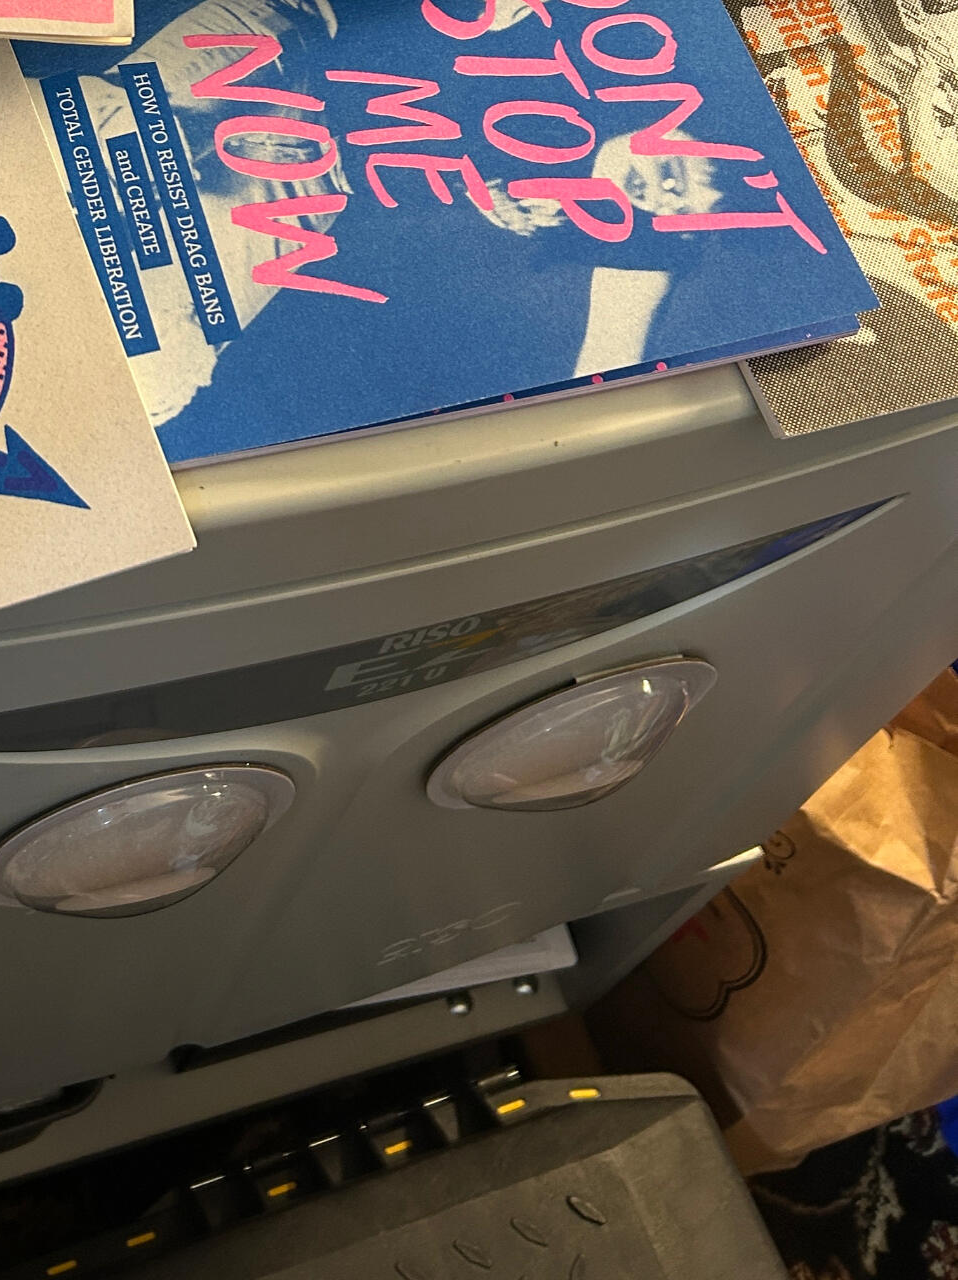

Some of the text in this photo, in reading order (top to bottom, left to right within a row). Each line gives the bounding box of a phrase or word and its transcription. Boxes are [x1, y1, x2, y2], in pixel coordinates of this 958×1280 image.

[56, 87, 142, 340] TOTAL GENDER LIBERATION
[115, 149, 160, 256] and CREATE
[133, 72, 225, 325] HOW TO RESIST DRAG BANS
[183, 33, 389, 304] NOW
[325, 70, 494, 212] ME
[378, 616, 482, 655] RISO
